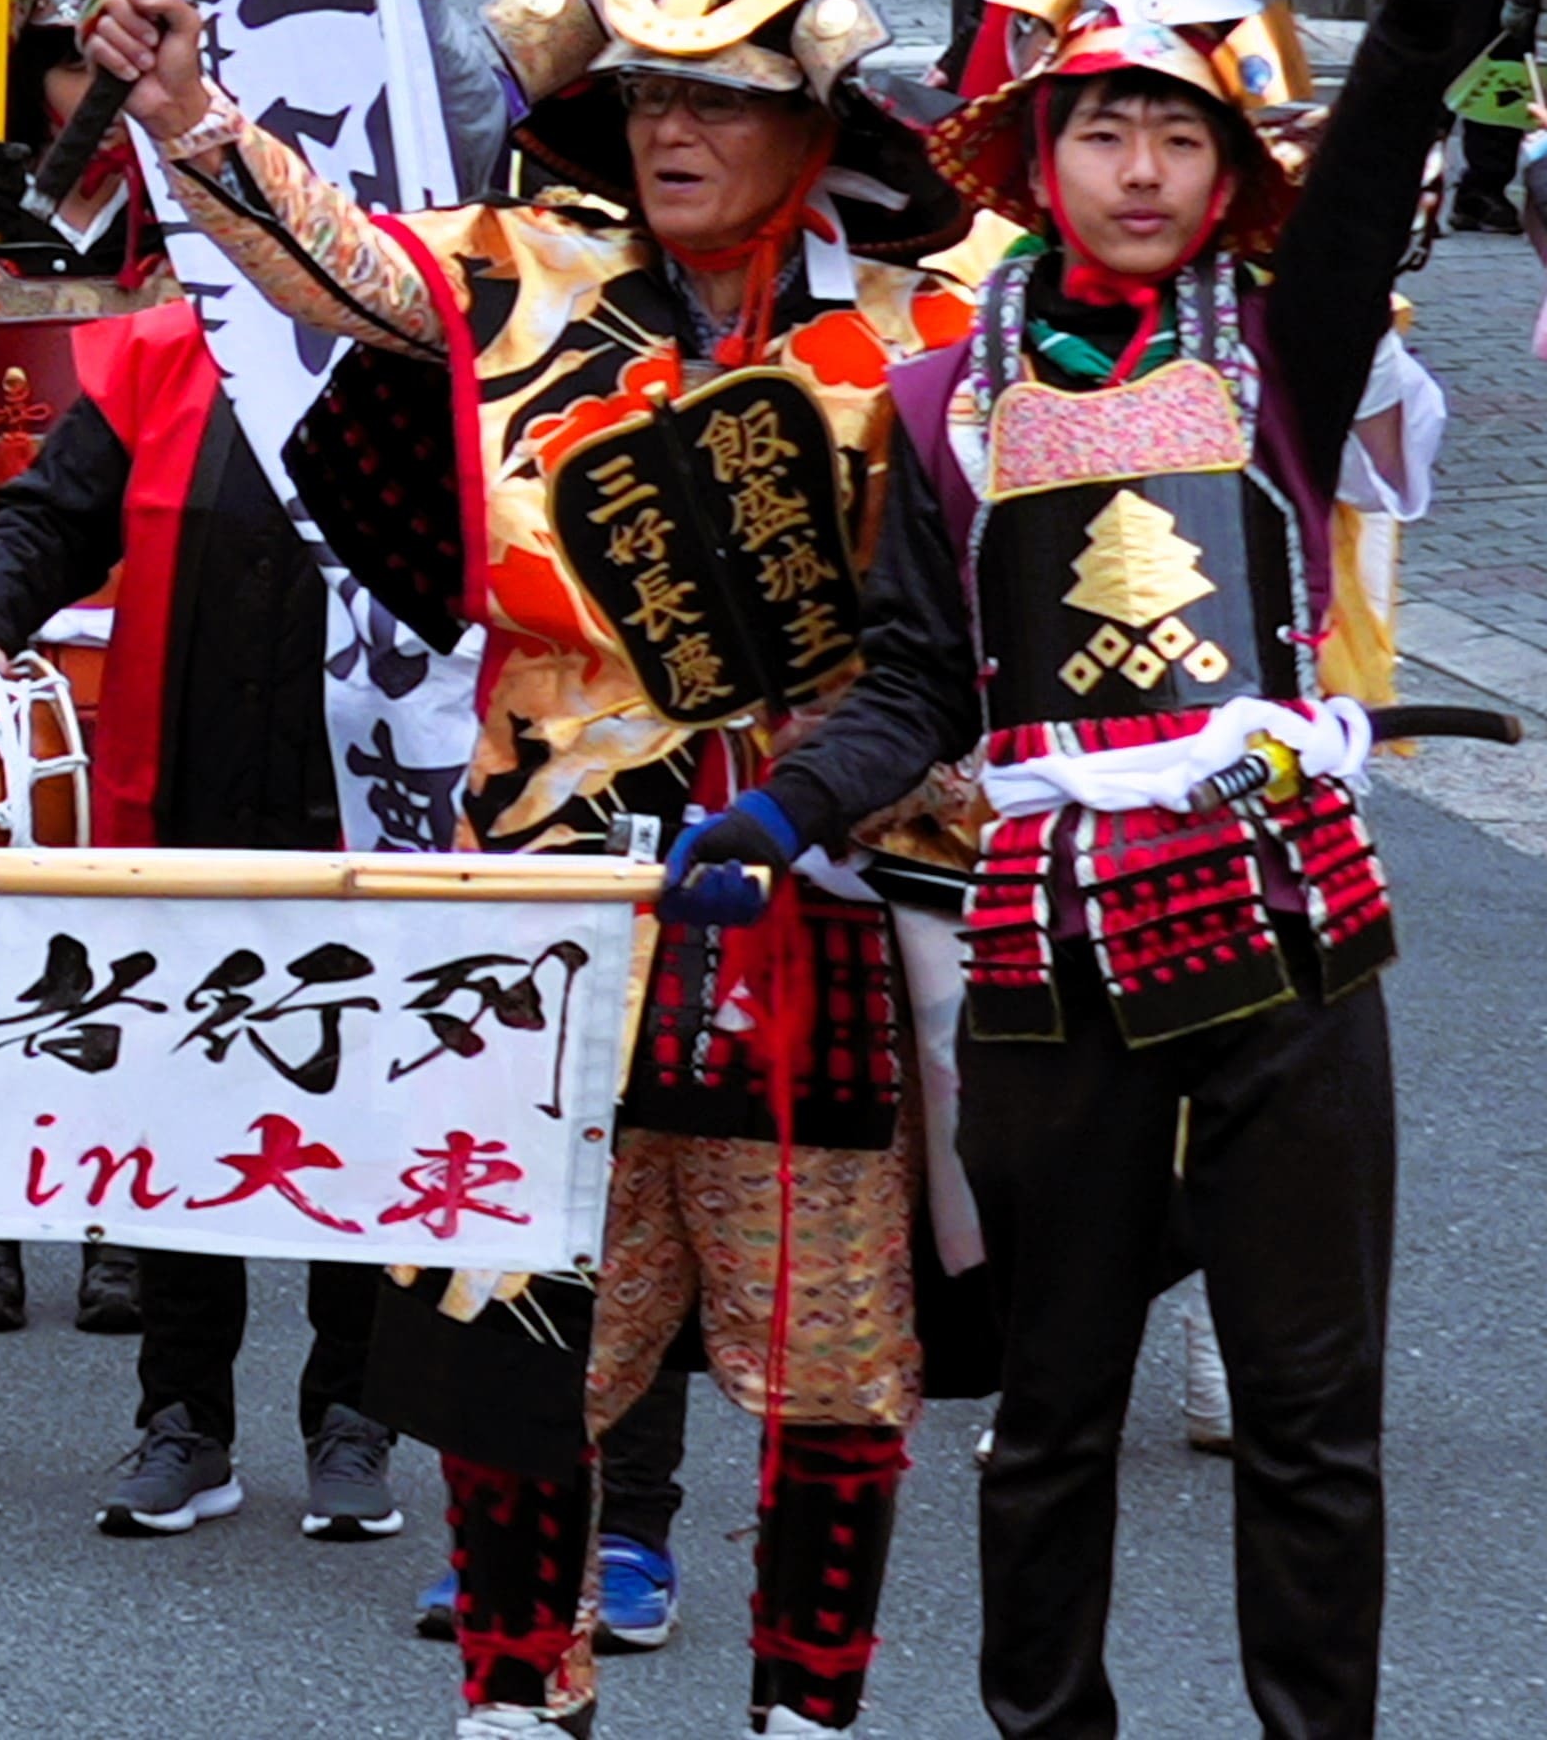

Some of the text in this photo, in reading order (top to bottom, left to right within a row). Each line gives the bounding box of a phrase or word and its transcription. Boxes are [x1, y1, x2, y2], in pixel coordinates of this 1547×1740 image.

[584, 458, 733, 717] 三好長慶
[696, 394, 855, 672] 飯盛城主
